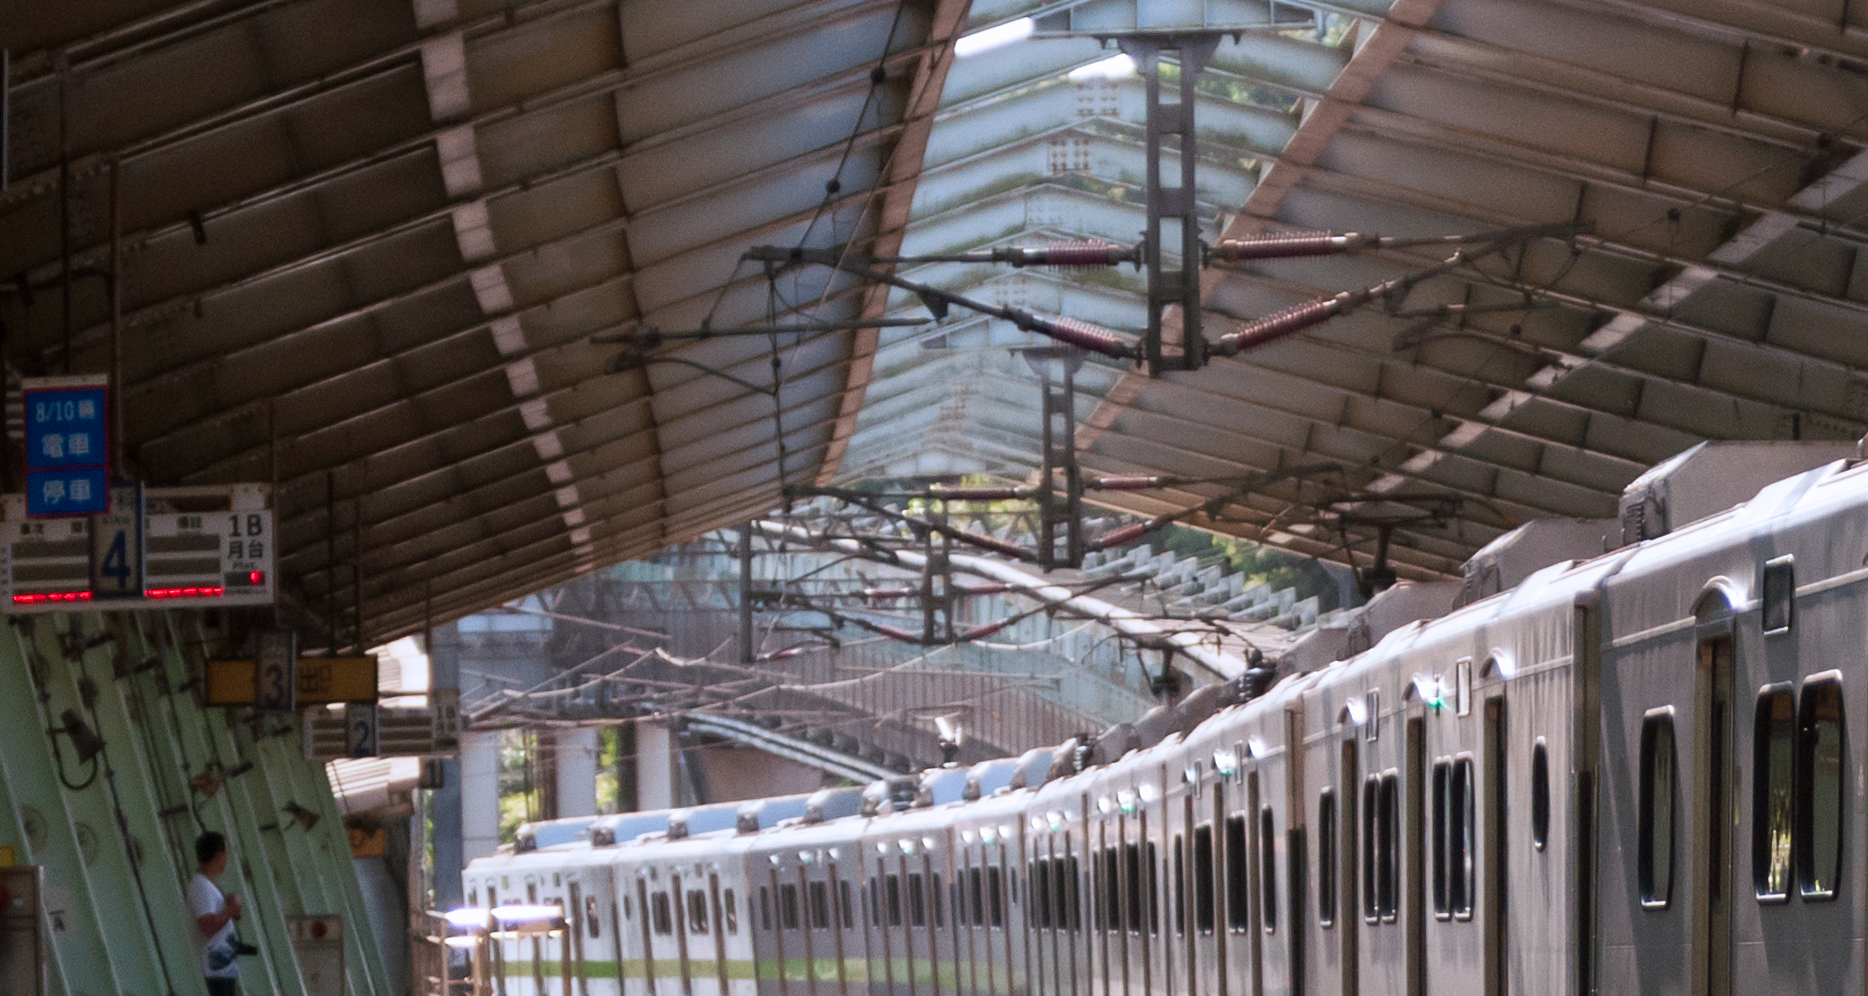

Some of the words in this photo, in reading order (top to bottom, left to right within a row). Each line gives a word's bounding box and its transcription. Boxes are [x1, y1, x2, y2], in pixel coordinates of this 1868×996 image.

[227, 513, 263, 537] 1B
[100, 529, 132, 589] 4
[227, 539, 264, 561] 月台
[264, 664, 285, 704] 3
[353, 719, 370, 757] 2
